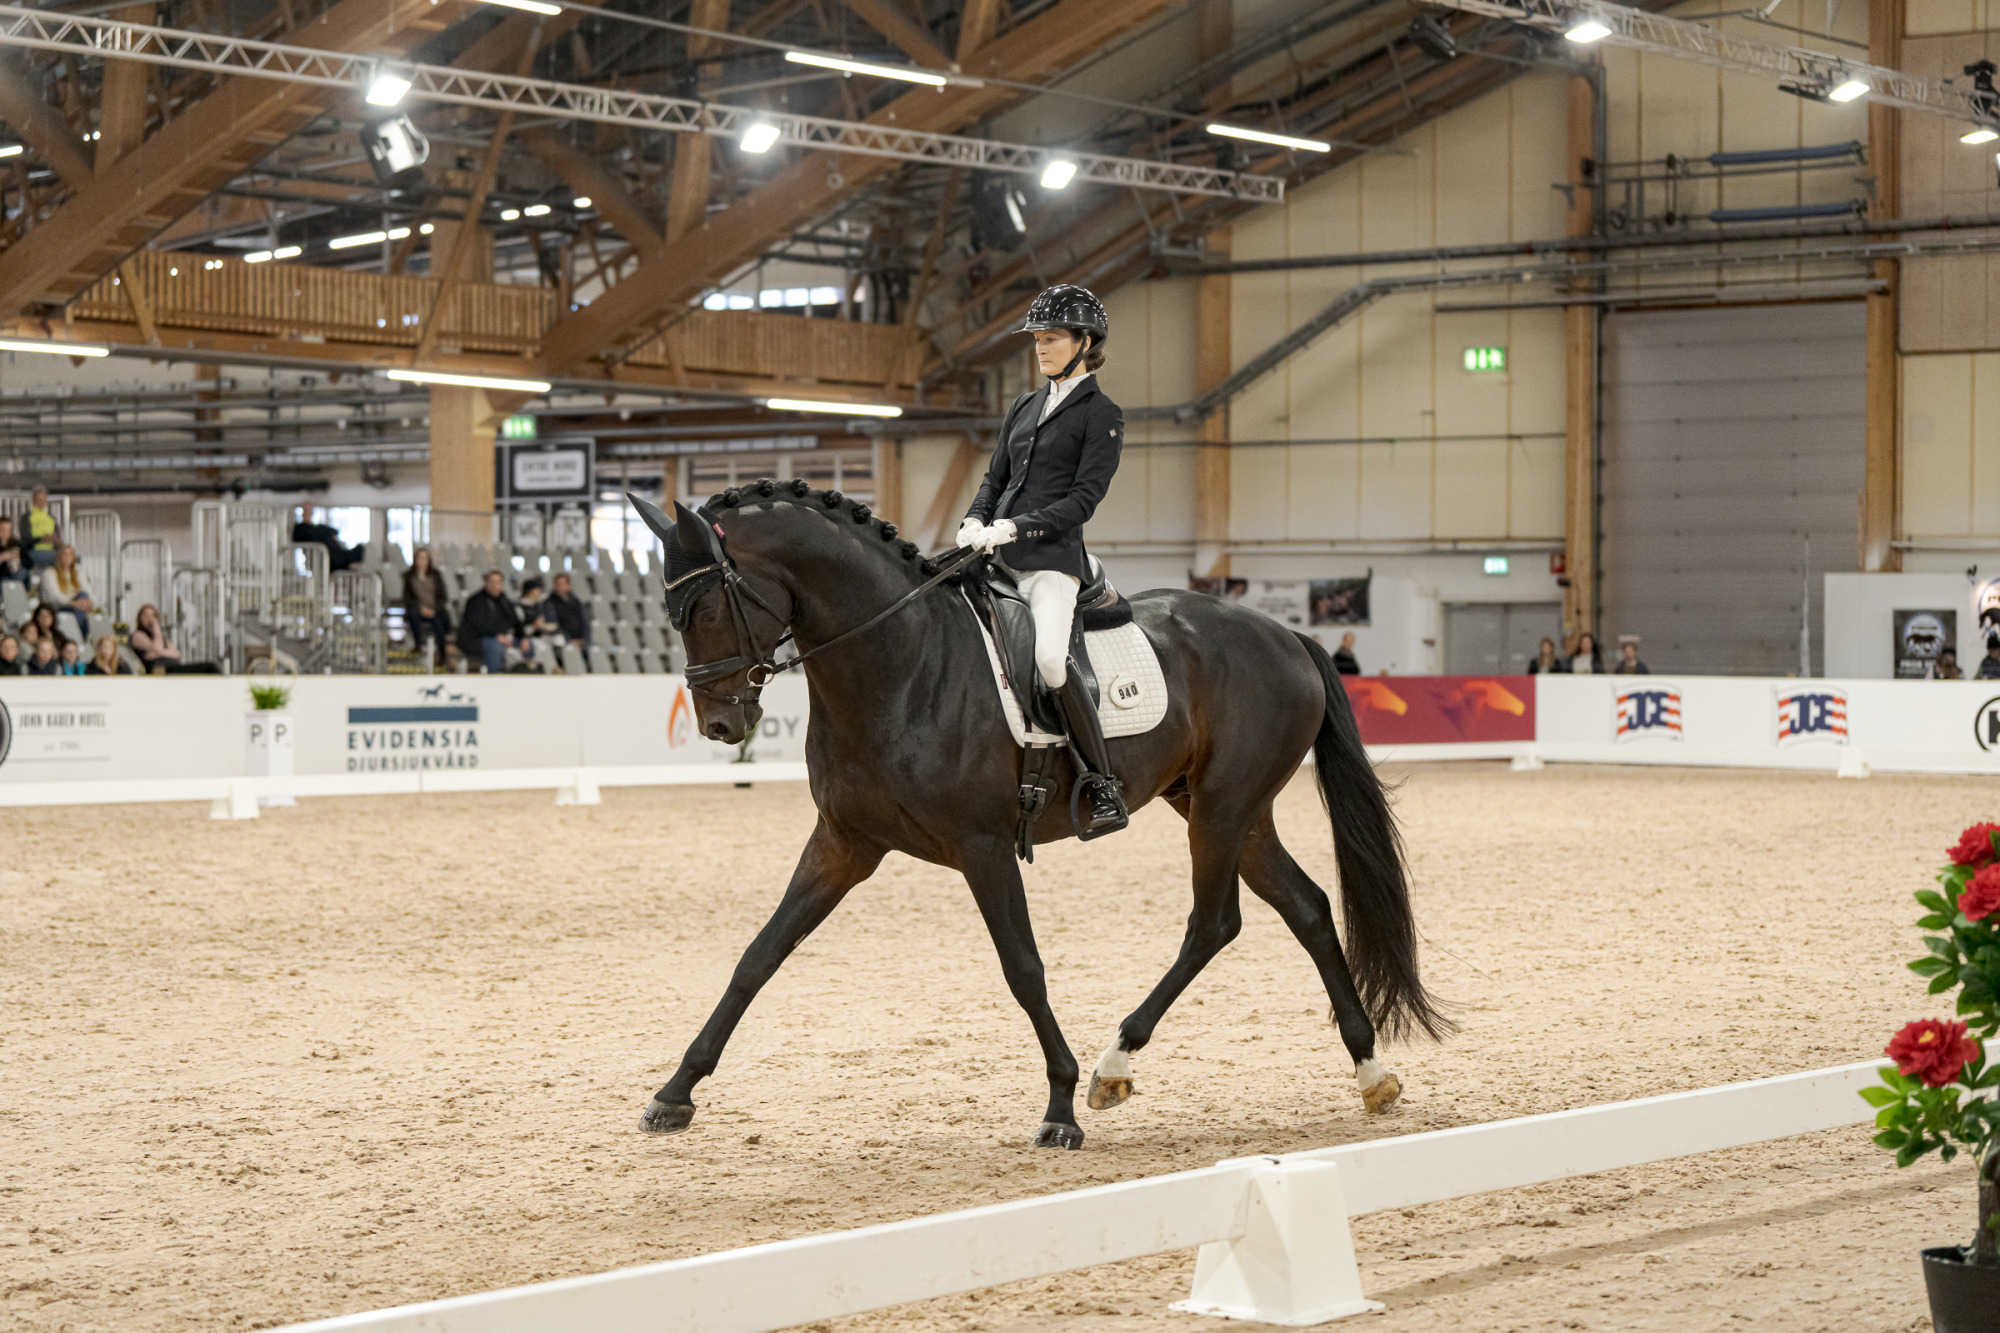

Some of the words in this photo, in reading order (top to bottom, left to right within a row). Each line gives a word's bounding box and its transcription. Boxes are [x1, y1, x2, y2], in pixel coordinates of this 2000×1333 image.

[1118, 684, 1138, 700] 940
[19, 712, 43, 729] JOHN
[79, 711, 106, 728] HOTEL
[250, 723, 263, 744] P
[275, 723, 288, 744] P
[347, 729, 479, 749] EVIDENSIA
[347, 750, 479, 772] DJURSJUKVÅRD
